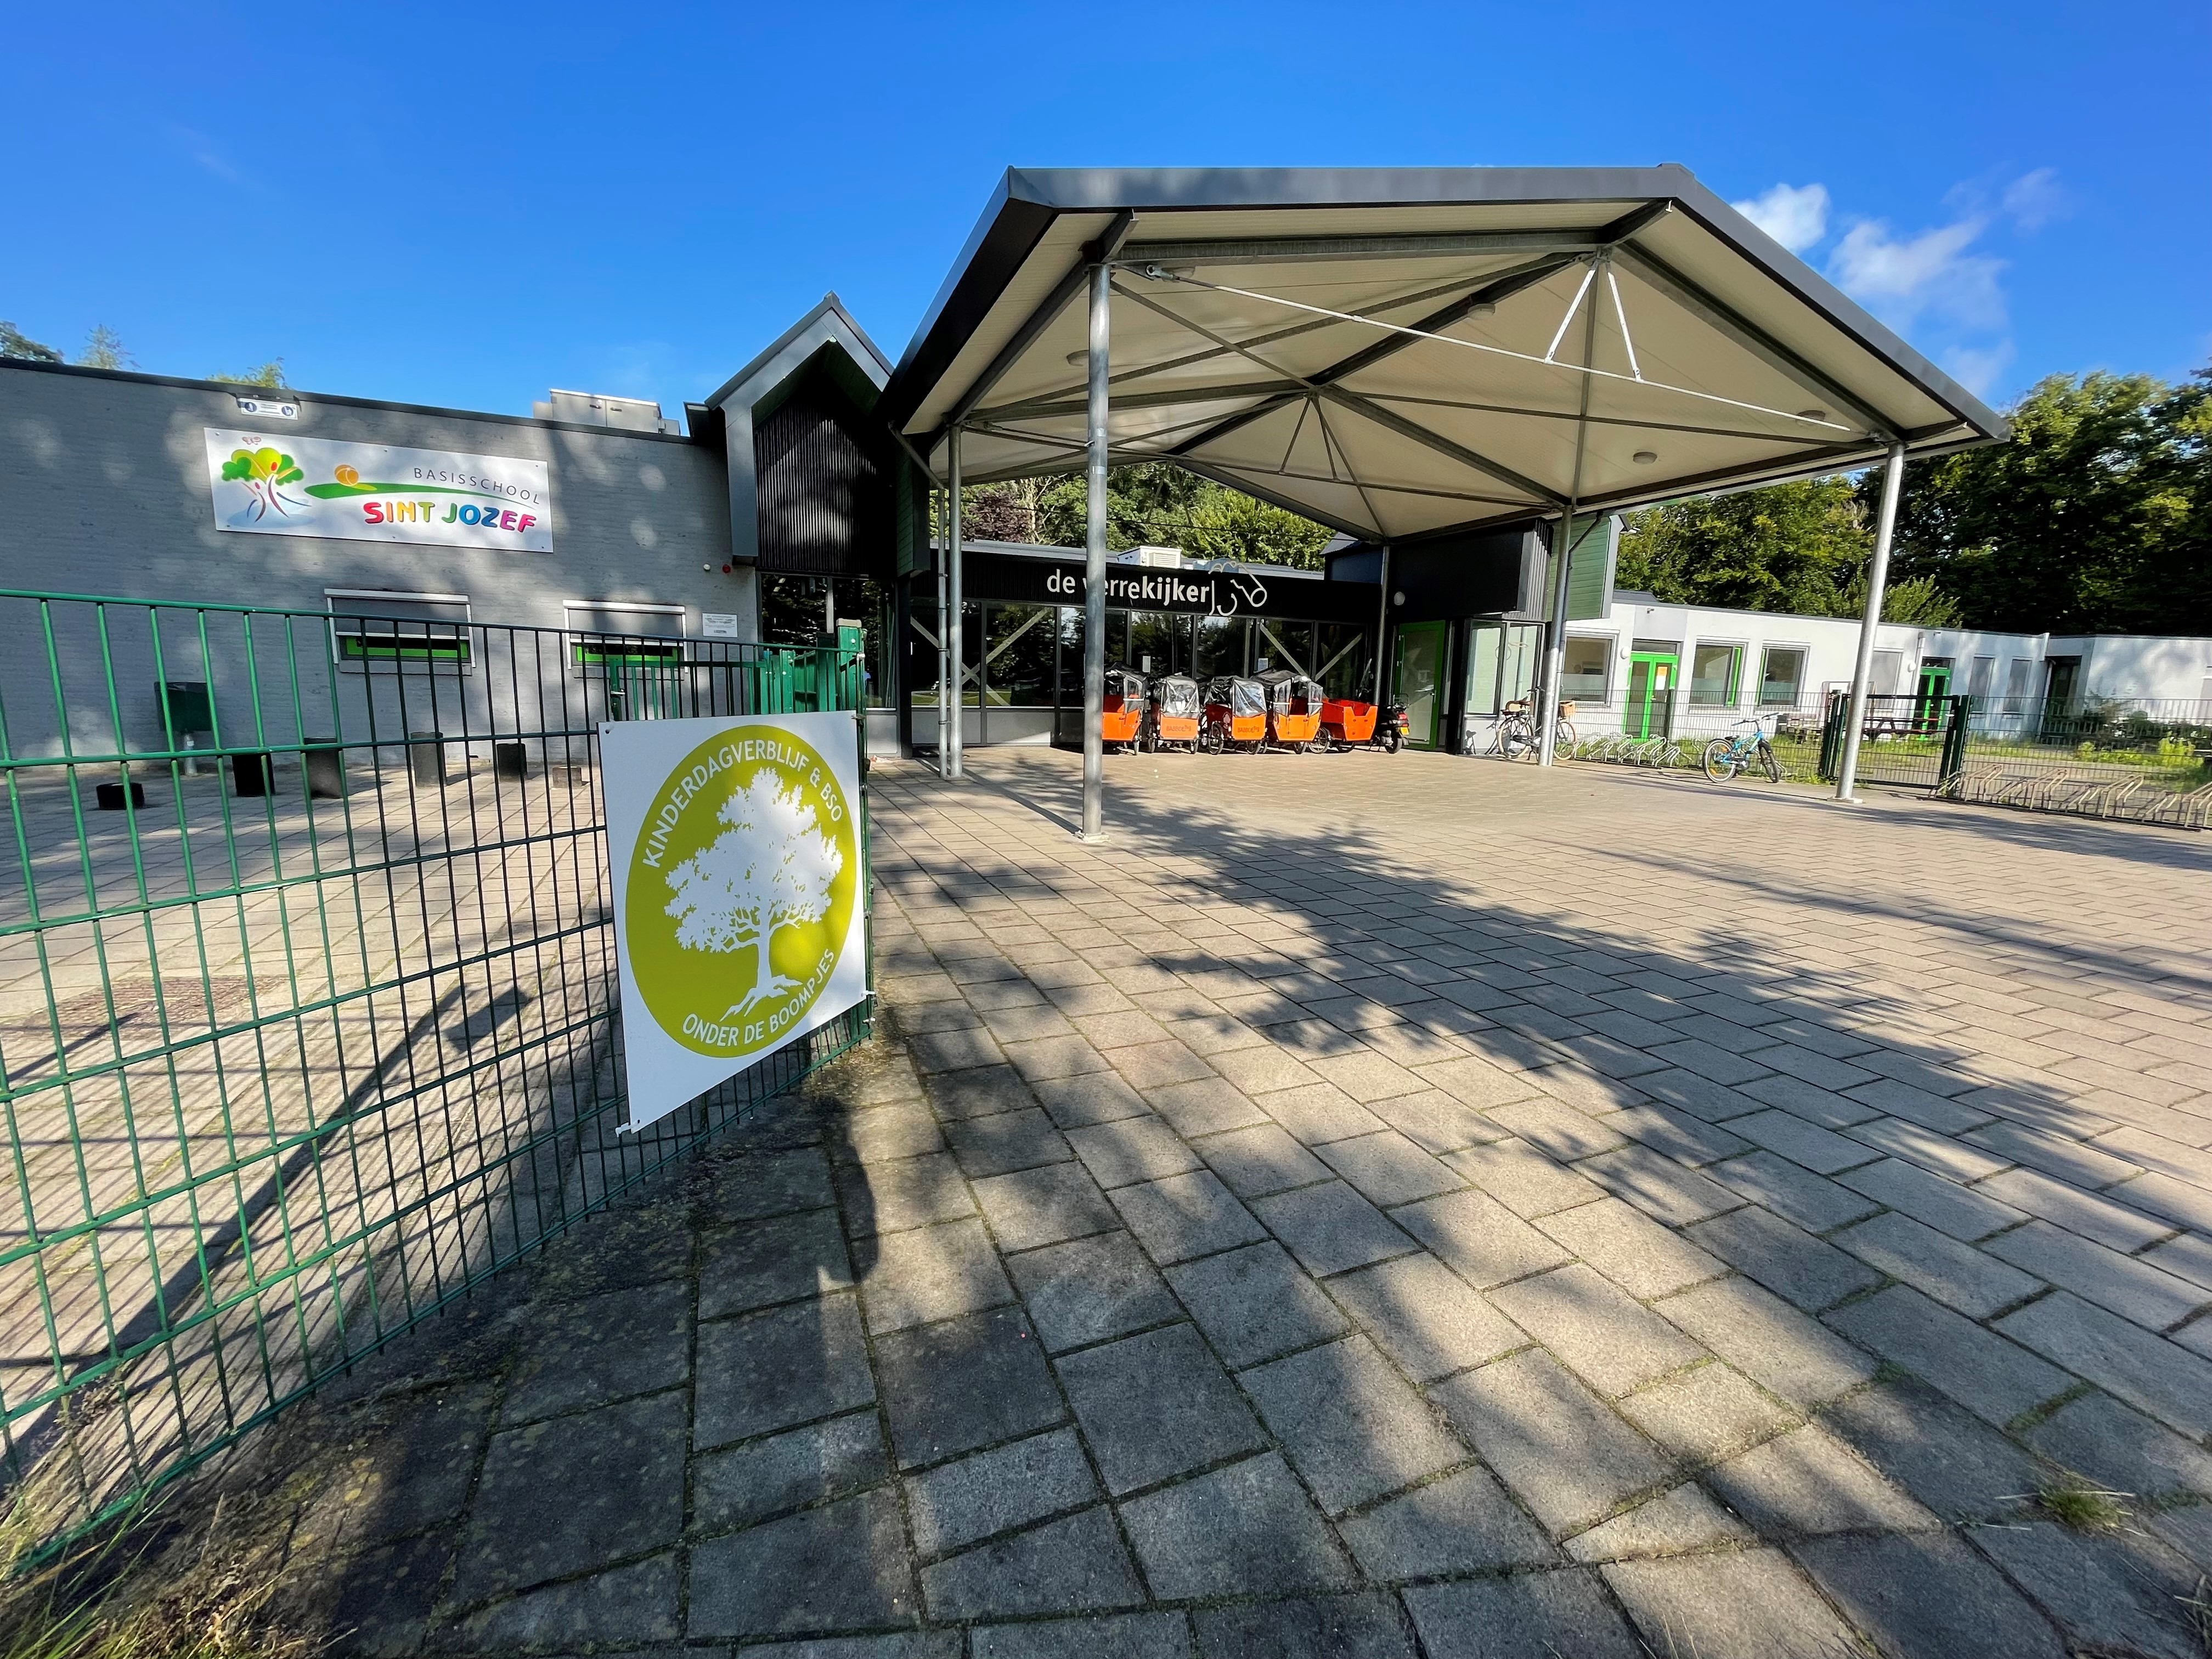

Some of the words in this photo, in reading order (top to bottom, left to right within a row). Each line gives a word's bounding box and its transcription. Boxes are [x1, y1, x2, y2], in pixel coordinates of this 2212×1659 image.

[414, 467, 540, 504] BASISSCHOOL
[363, 501, 435, 523] SINT
[441, 503, 536, 532] JOZEF
[1047, 568, 1075, 594] de
[1082, 575, 1210, 606] rrekijker
[642, 740, 809, 868] KINDERDAGVERBLIJF
[809, 767, 821, 788] &
[820, 782, 842, 822] BSO
[682, 1013, 738, 1046] ONDER
[744, 1020, 764, 1044] DE
[769, 949, 834, 1033] BOOMPJES
